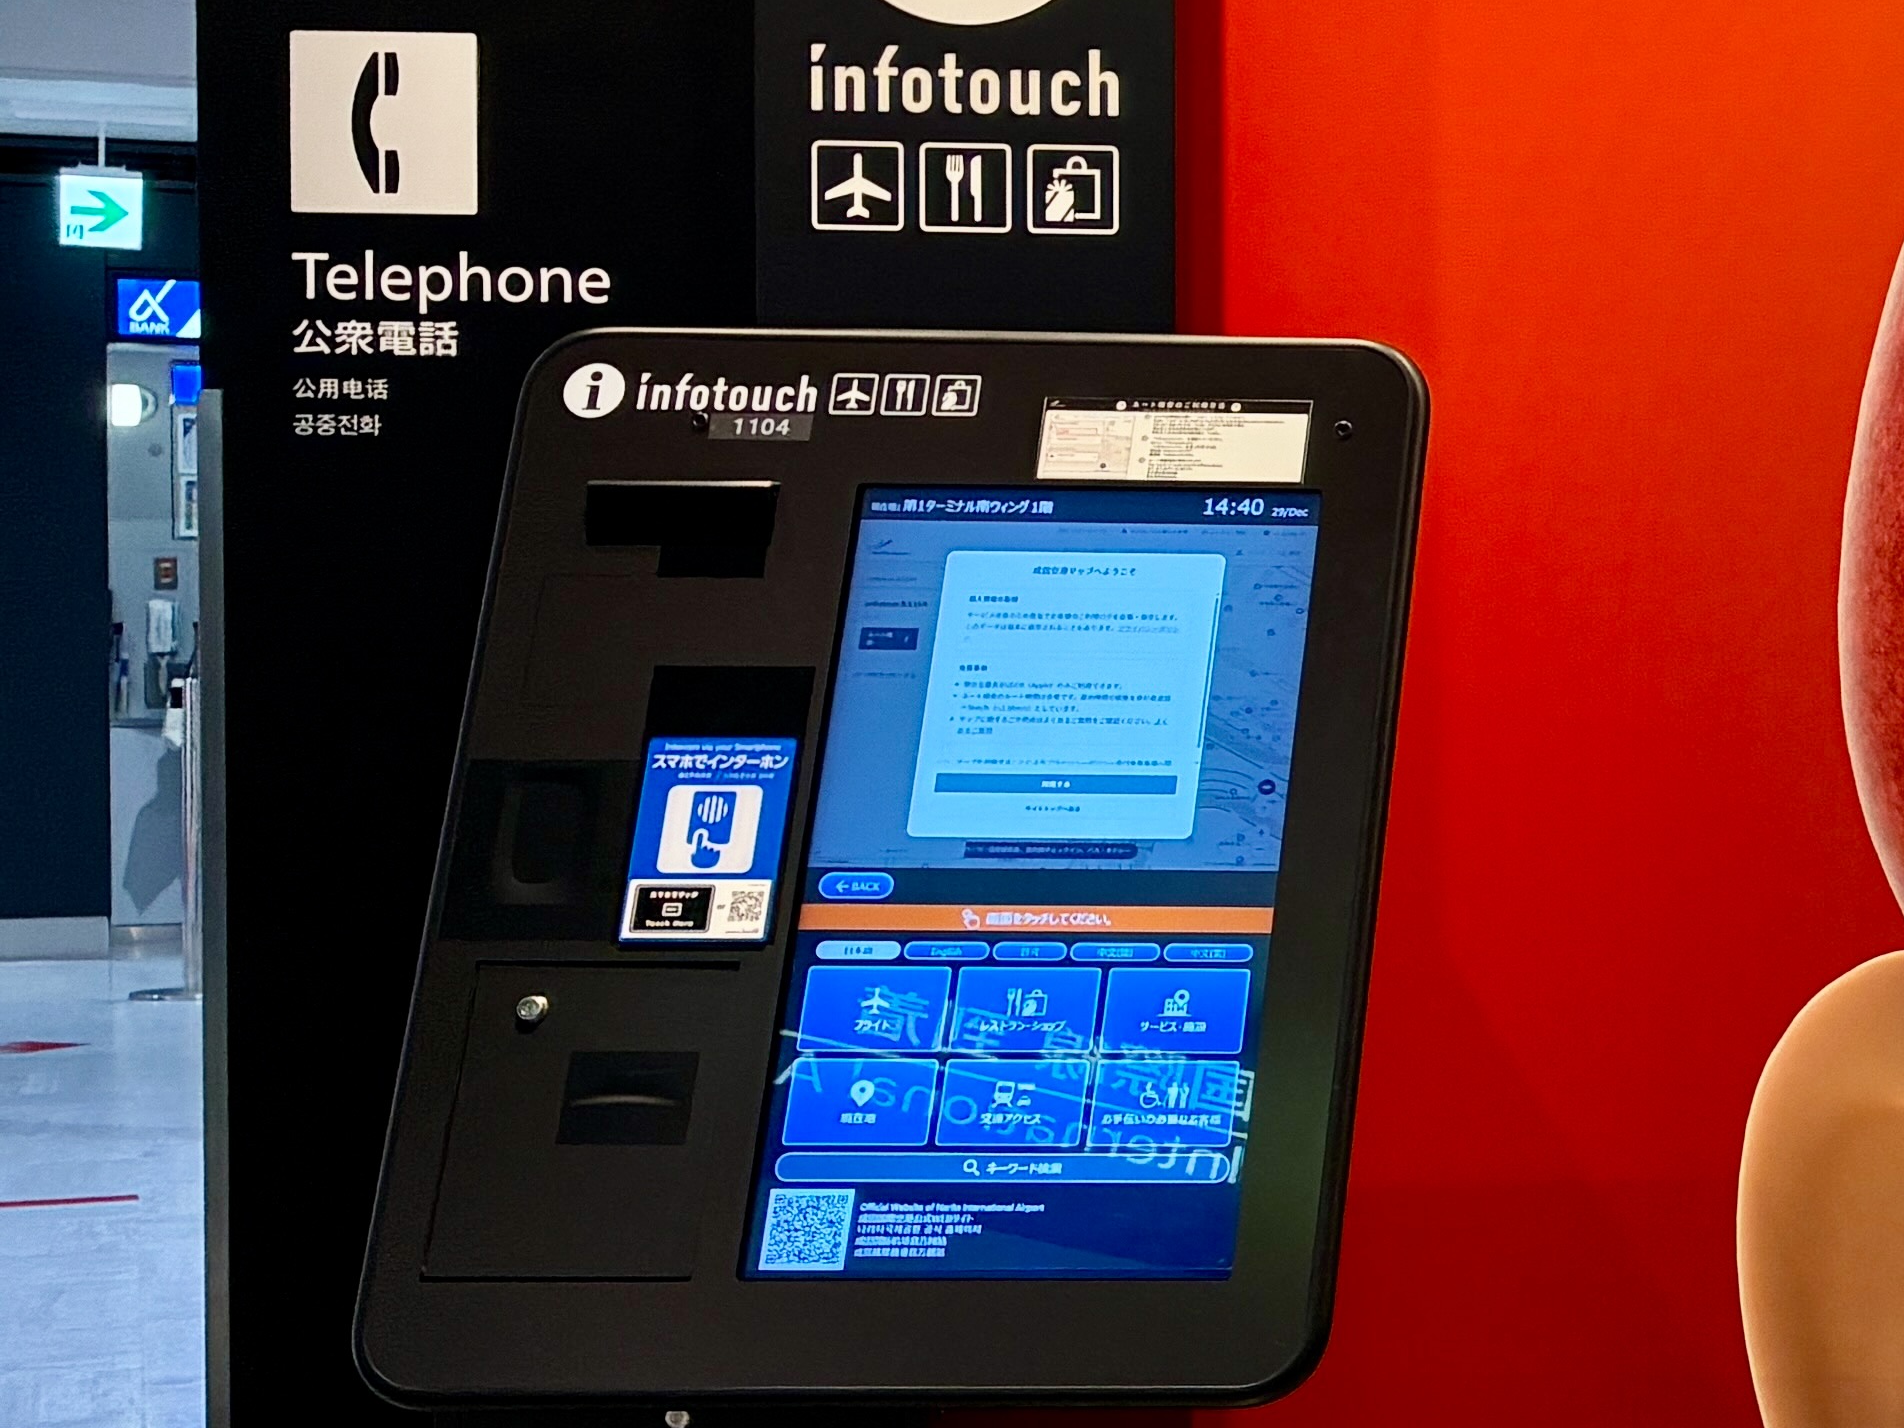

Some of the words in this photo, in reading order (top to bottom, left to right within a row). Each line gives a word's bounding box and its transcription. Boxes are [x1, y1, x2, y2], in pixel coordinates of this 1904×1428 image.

[810, 43, 1120, 117] infotouch
[291, 249, 611, 315] Telephone
[292, 318, 459, 357] 公衆電話
[292, 377, 389, 400] 公用电话
[636, 373, 818, 412] infotouch
[292, 413, 383, 437] 공중전화
[732, 417, 792, 438] 1104
[1203, 498, 1265, 516] 14:40
[651, 753, 789, 770] スマホでインターホン
[851, 880, 881, 893] BACK
